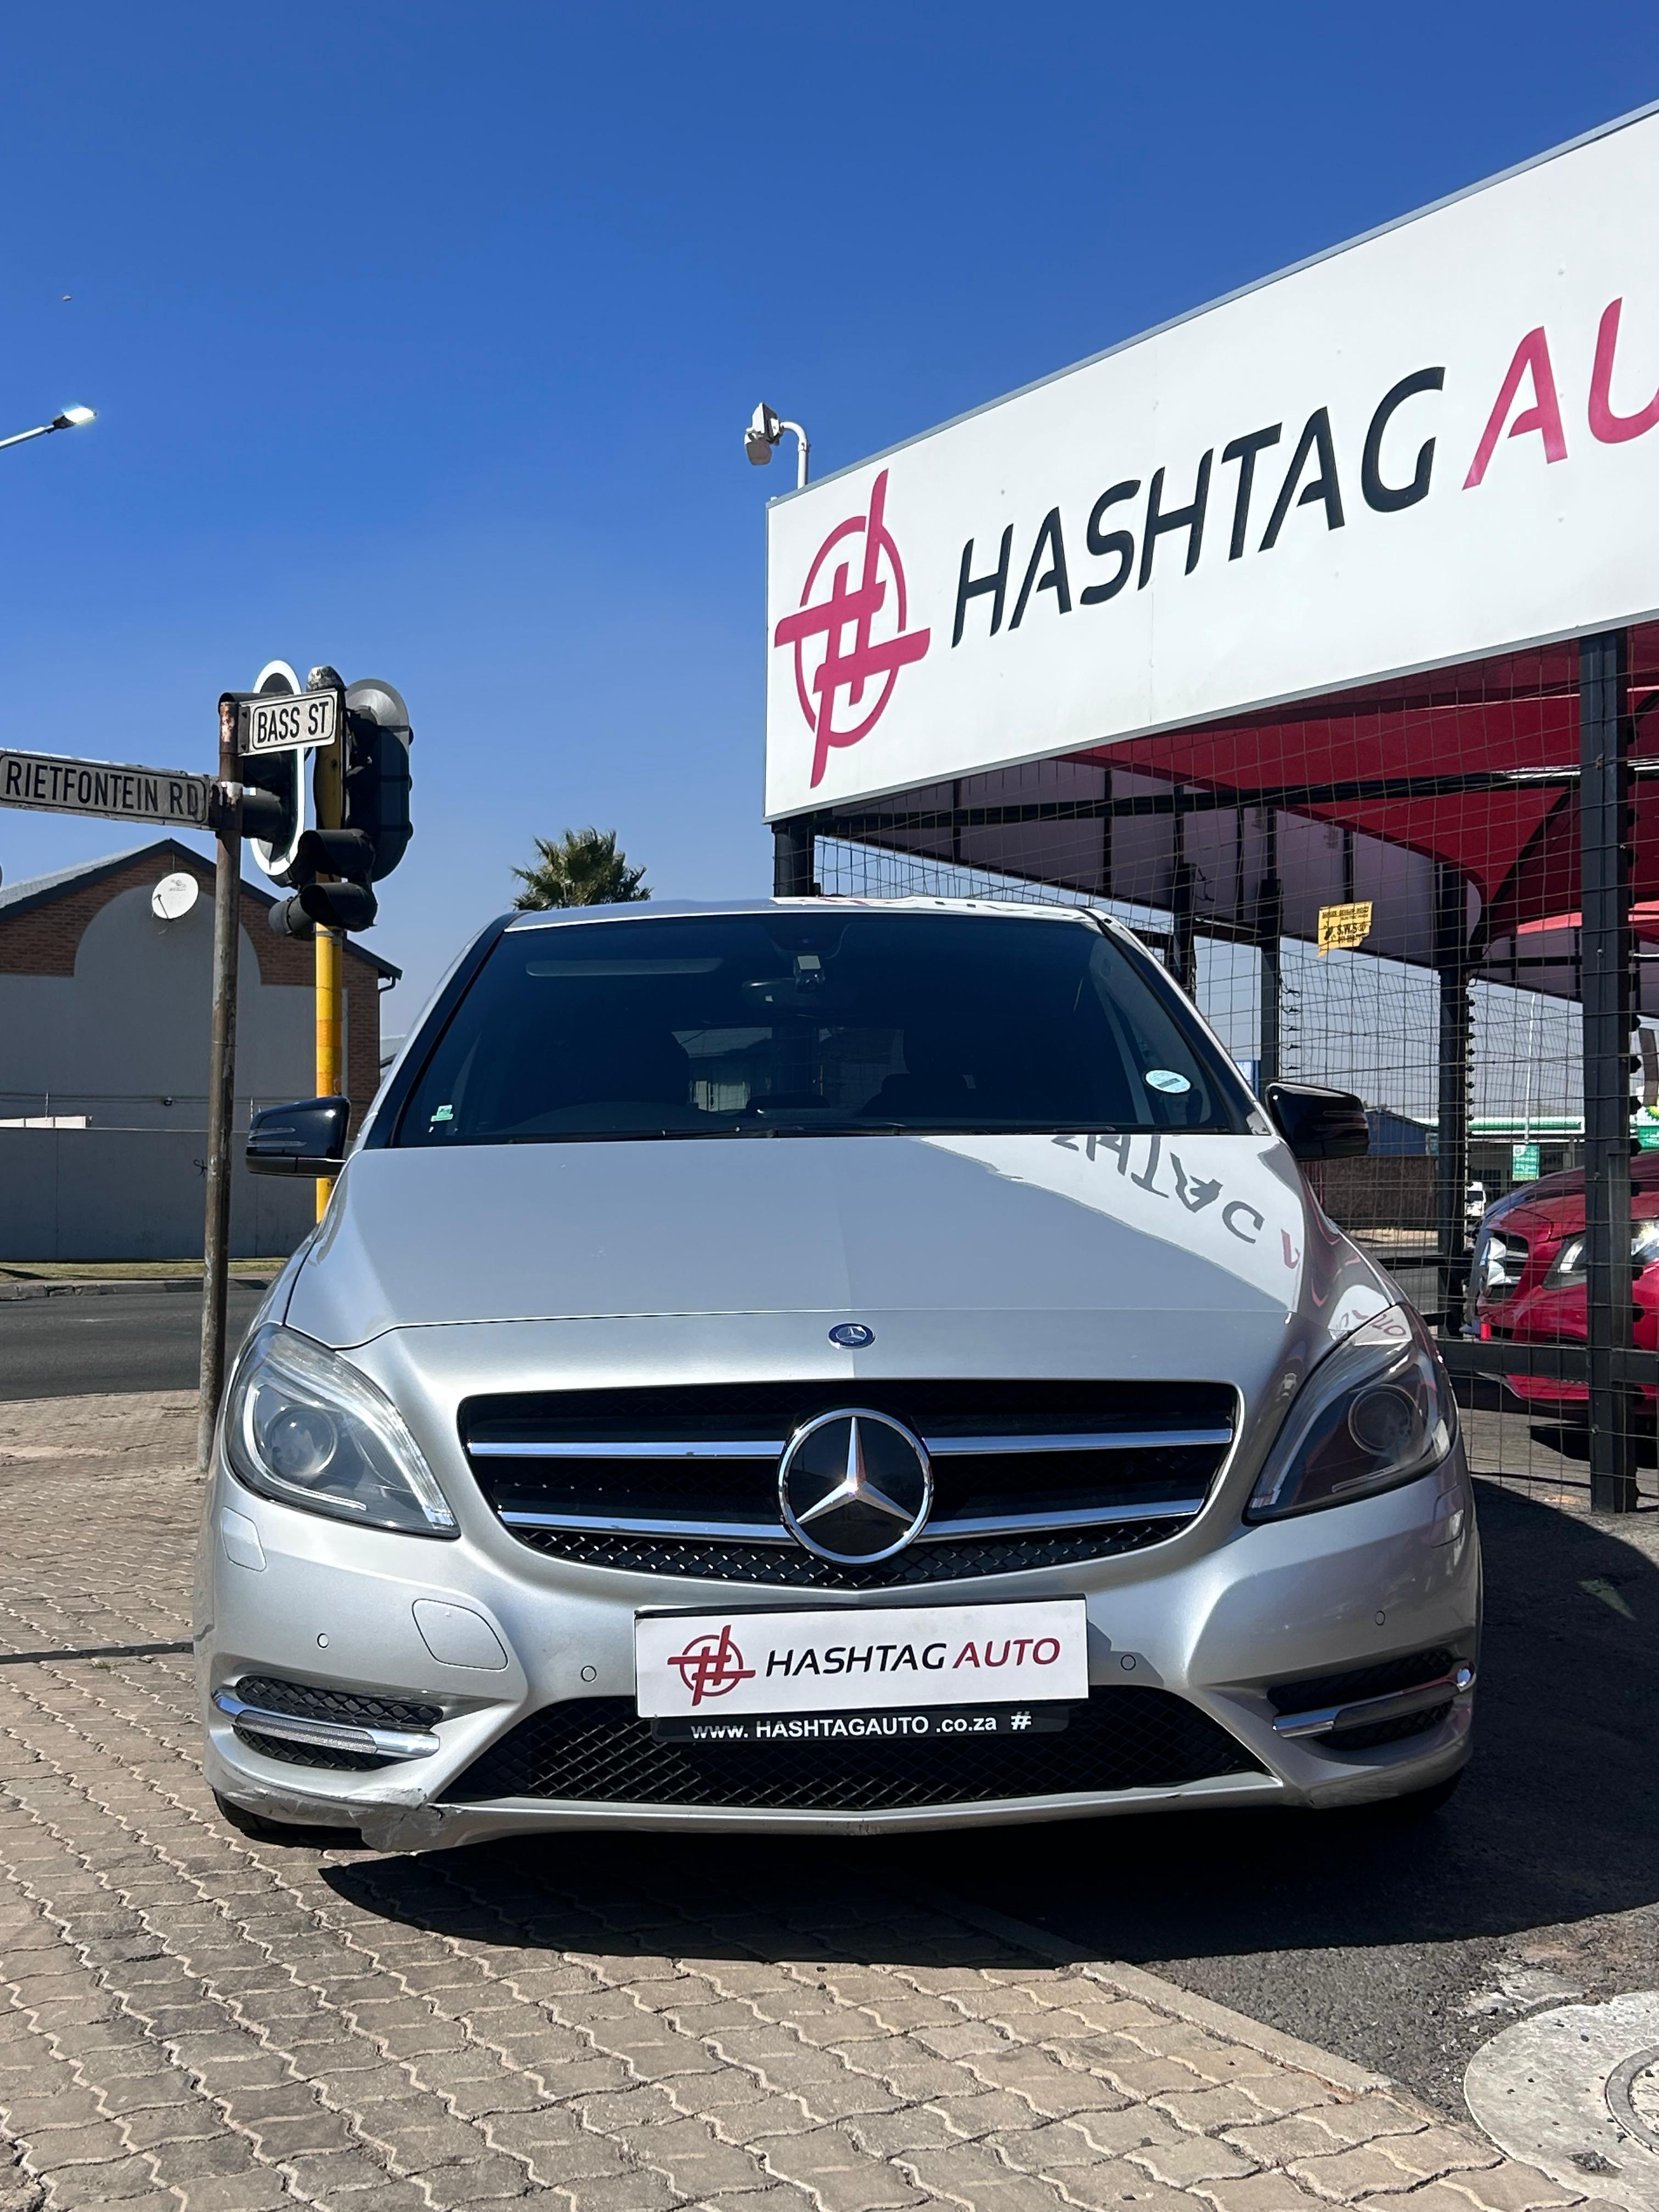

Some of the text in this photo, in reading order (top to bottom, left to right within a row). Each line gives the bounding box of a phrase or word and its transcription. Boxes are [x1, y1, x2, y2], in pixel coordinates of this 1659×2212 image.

[952, 367, 1445, 648] HASHTAG
[257, 701, 329, 743] BASS ST
[5, 760, 199, 816] RIETFONTEIN RD
[766, 1638, 1060, 1677] HASHTAG AUTO
[691, 1725, 748, 1739] www.
[757, 1716, 929, 1738] HASHTAGAUTO
[936, 1718, 997, 1733] .co.za
